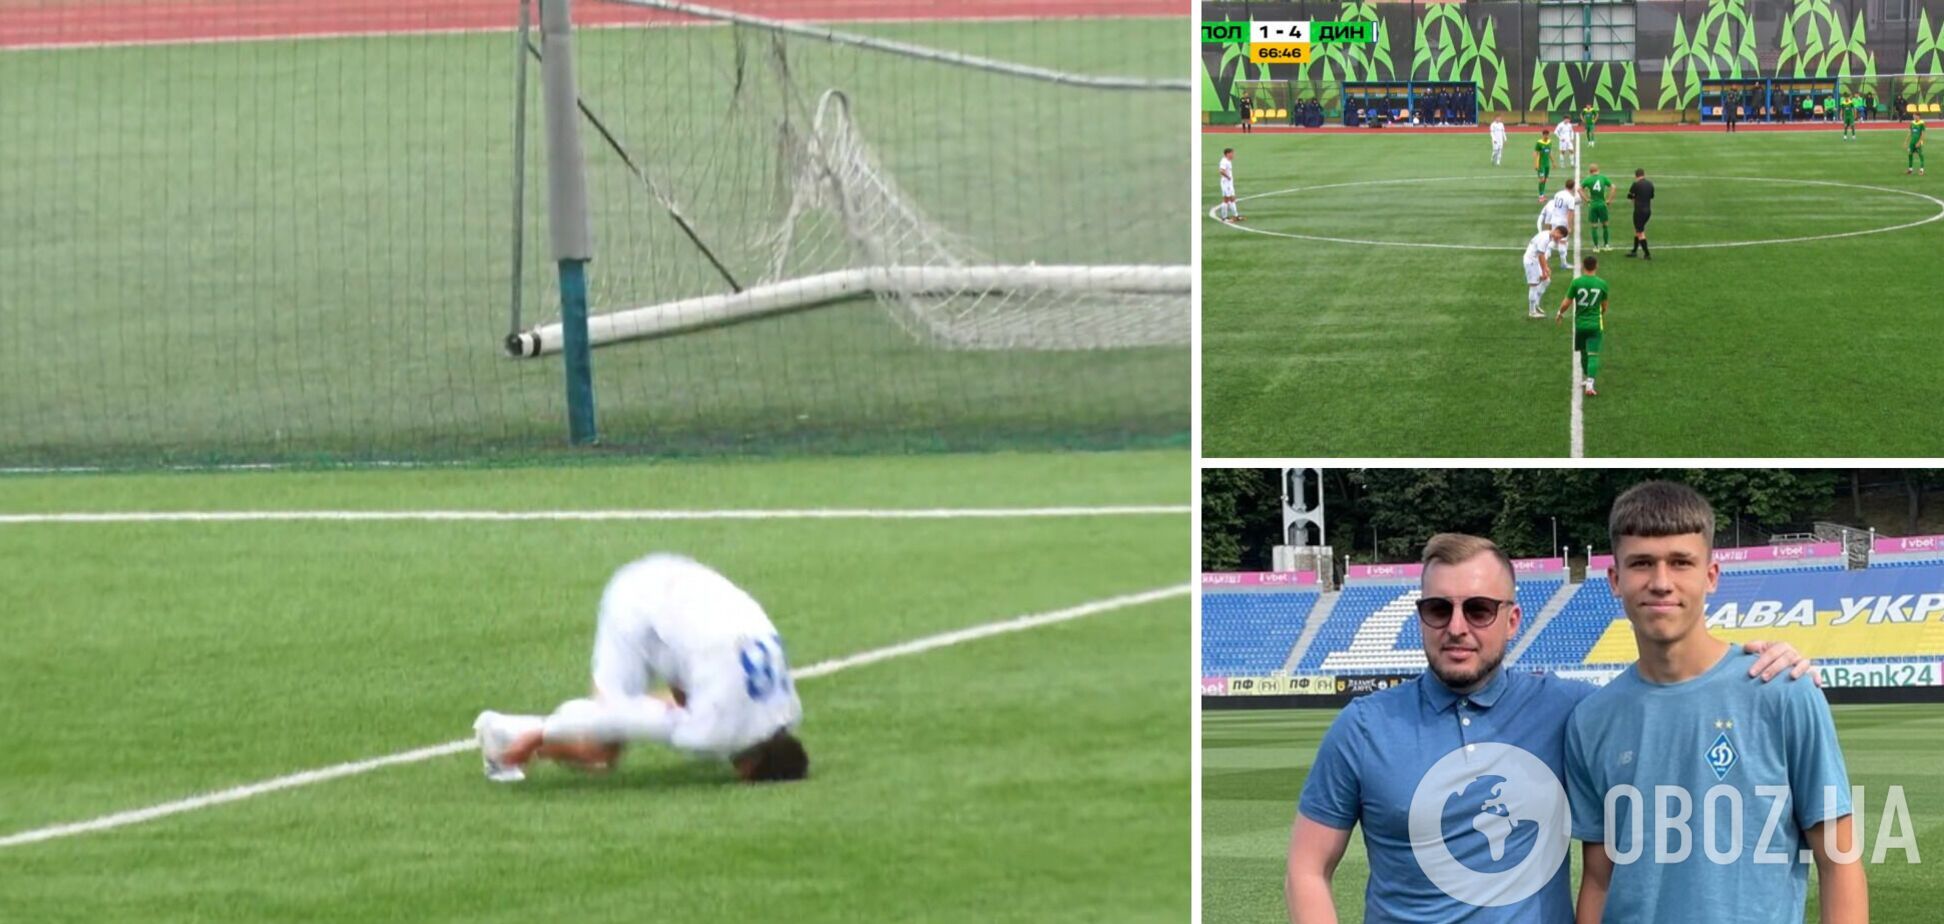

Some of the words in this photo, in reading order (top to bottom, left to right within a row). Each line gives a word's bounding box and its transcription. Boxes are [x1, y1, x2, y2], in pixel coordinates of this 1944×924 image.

[1593, 178, 1601, 192] 4
[1577, 287, 1600, 306] 27
[1909, 537, 1934, 548] vbet
[1781, 546, 1803, 556] vbet
[1373, 566, 1394, 575] vbet
[1265, 573, 1288, 582] vbet
[1704, 599, 1816, 629] АВА
[1820, 664, 1934, 687] ABank24
